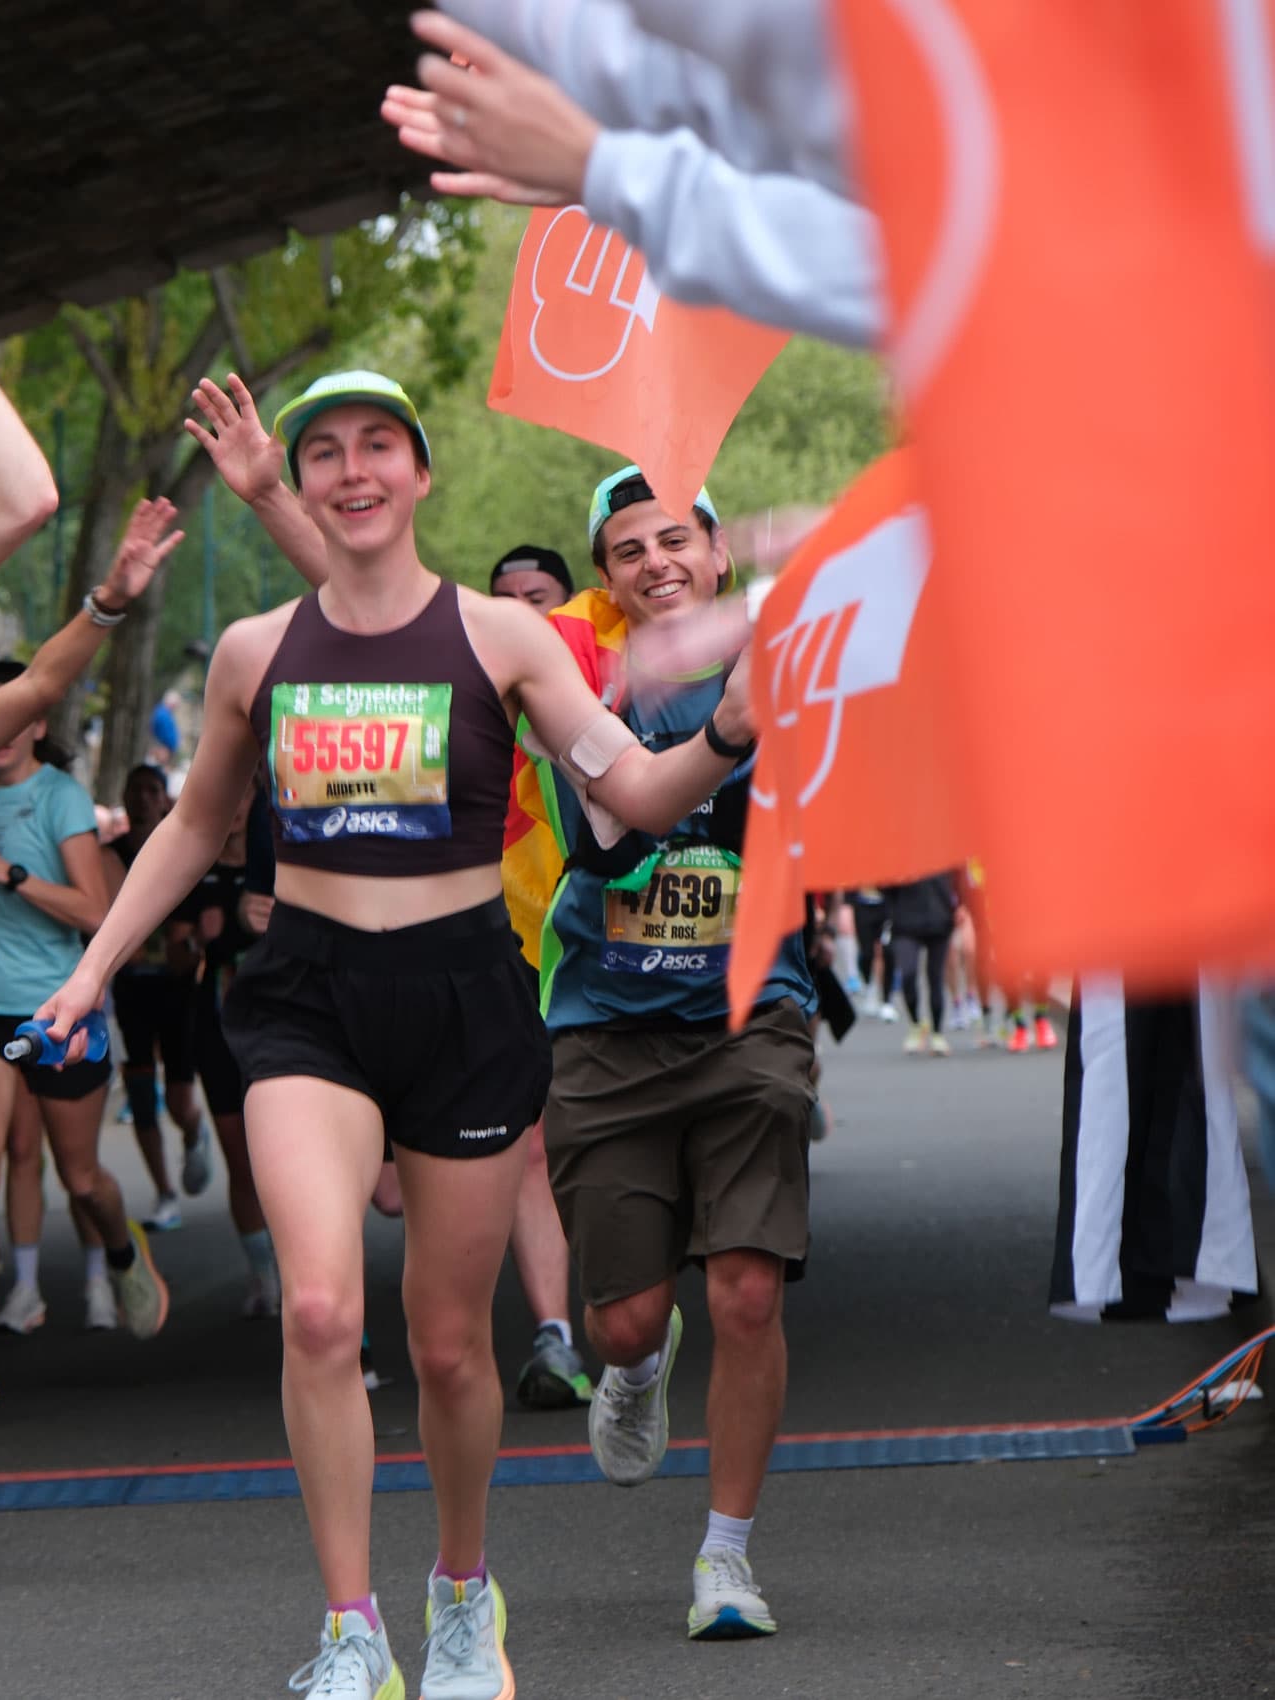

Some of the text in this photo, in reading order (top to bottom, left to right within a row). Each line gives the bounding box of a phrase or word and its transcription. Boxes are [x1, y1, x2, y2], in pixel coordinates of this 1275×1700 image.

[320, 684, 429, 706] Schneider
[293, 721, 410, 774] 55597
[326, 780, 377, 800] AUDETTE
[346, 811, 399, 833] asics
[642, 922, 697, 941] JOSÉ ROSÉ
[661, 954, 707, 970] asics
[459, 1125, 507, 1139] Newline
